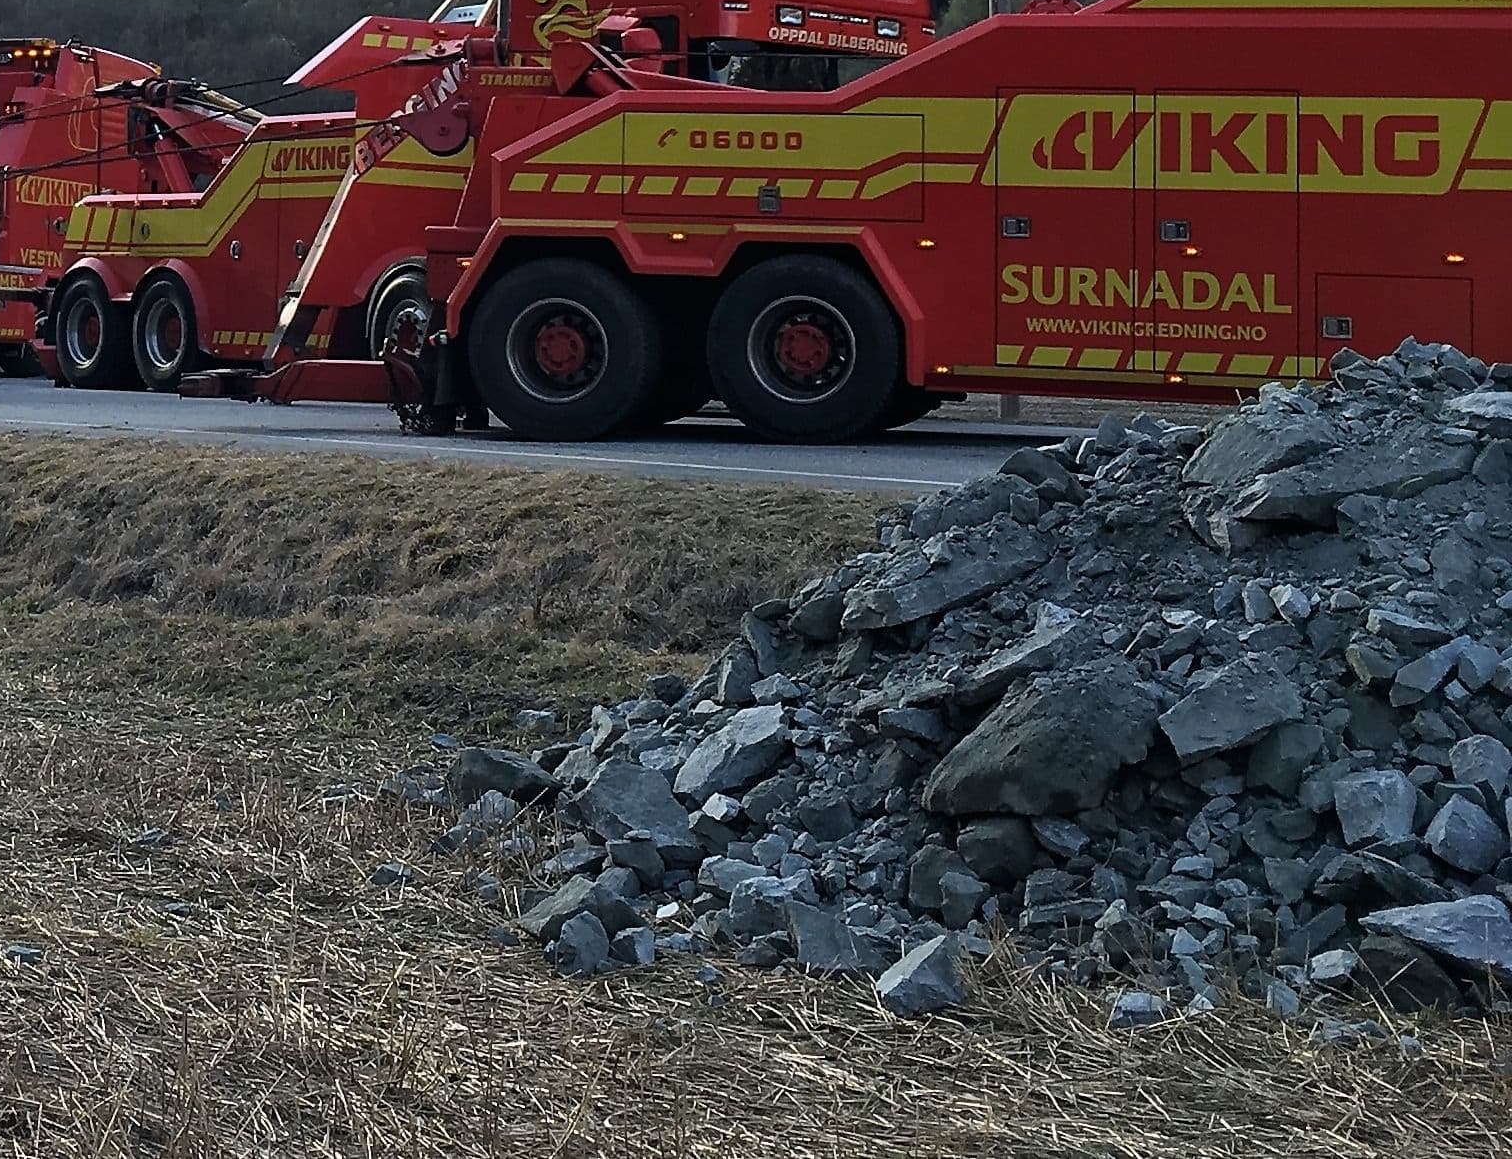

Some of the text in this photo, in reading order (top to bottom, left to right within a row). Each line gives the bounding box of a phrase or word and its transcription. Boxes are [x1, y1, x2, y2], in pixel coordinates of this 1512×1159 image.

[768, 26, 908, 56] OPPDAL BILBERGING
[689, 130, 803, 150] 06000
[1092, 110, 1440, 177] VIKING
[282, 145, 350, 171] VIKING
[20, 247, 63, 268] VESTN
[1001, 264, 1292, 314] SURNADAL
[1026, 317, 1267, 342] WWW.VIKINGREDNING.NO
